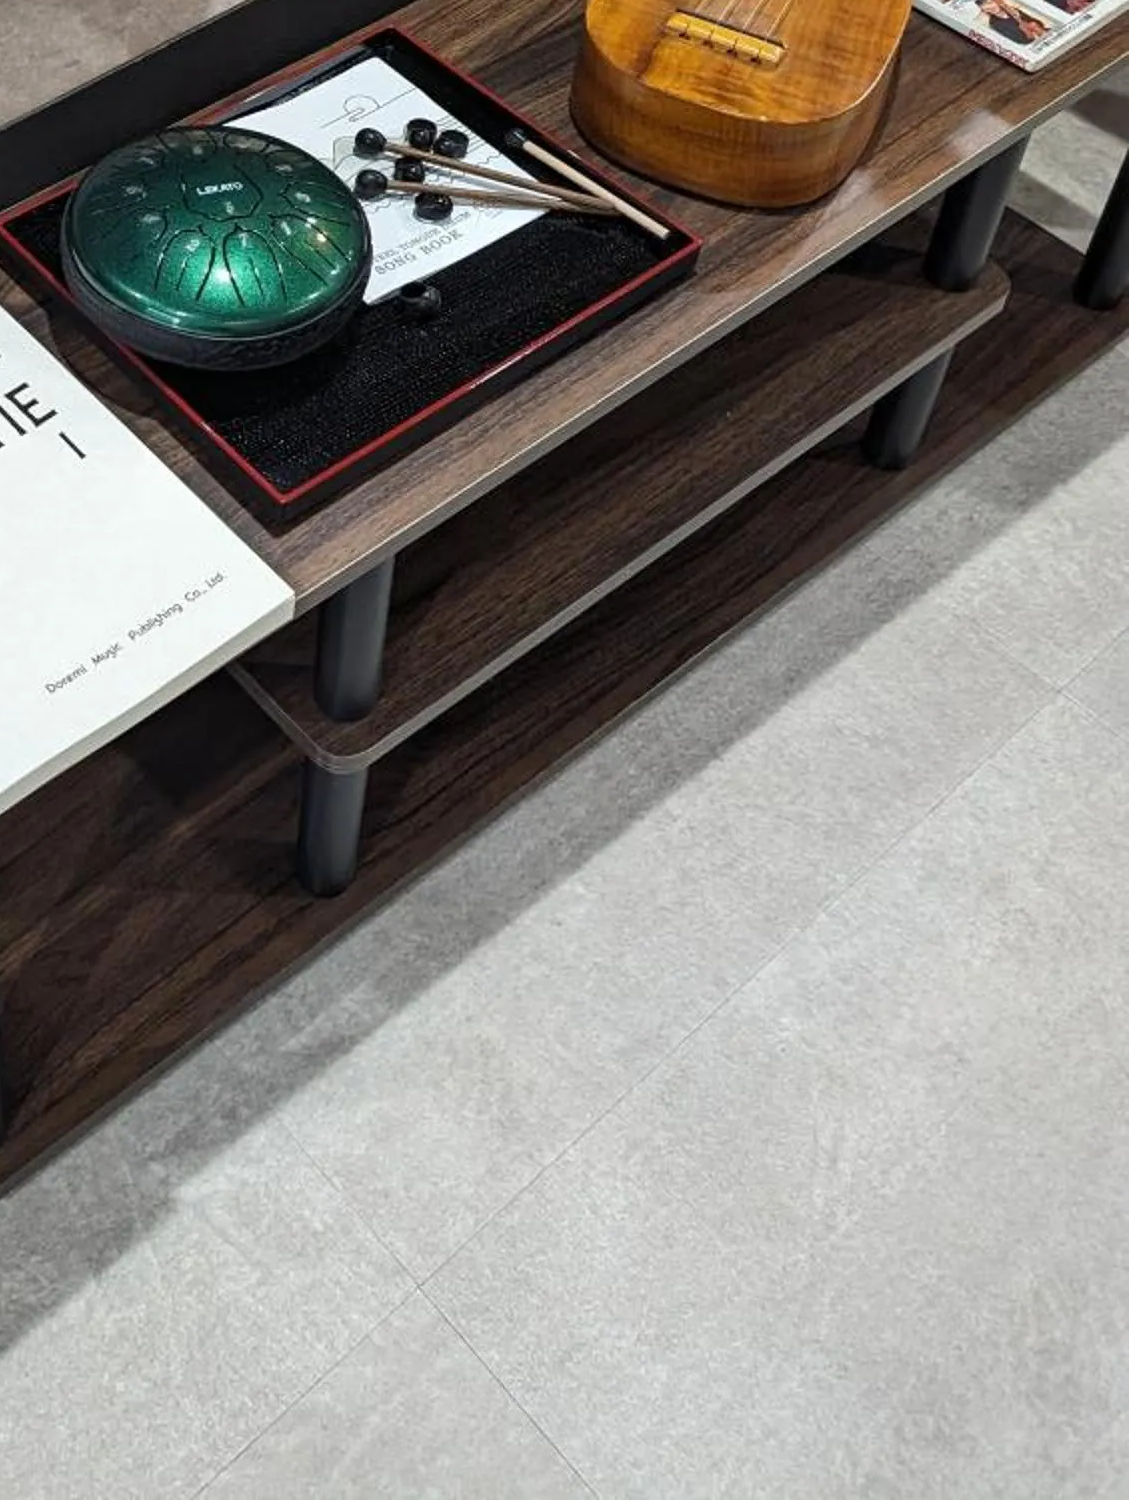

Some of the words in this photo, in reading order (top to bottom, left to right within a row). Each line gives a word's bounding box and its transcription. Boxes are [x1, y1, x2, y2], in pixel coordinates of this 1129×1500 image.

[374, 251, 417, 275] SONG
[419, 228, 464, 255] BOOK
[45, 665, 88, 693] Doremi
[91, 642, 122, 669] Music
[127, 603, 184, 641] Publishing
